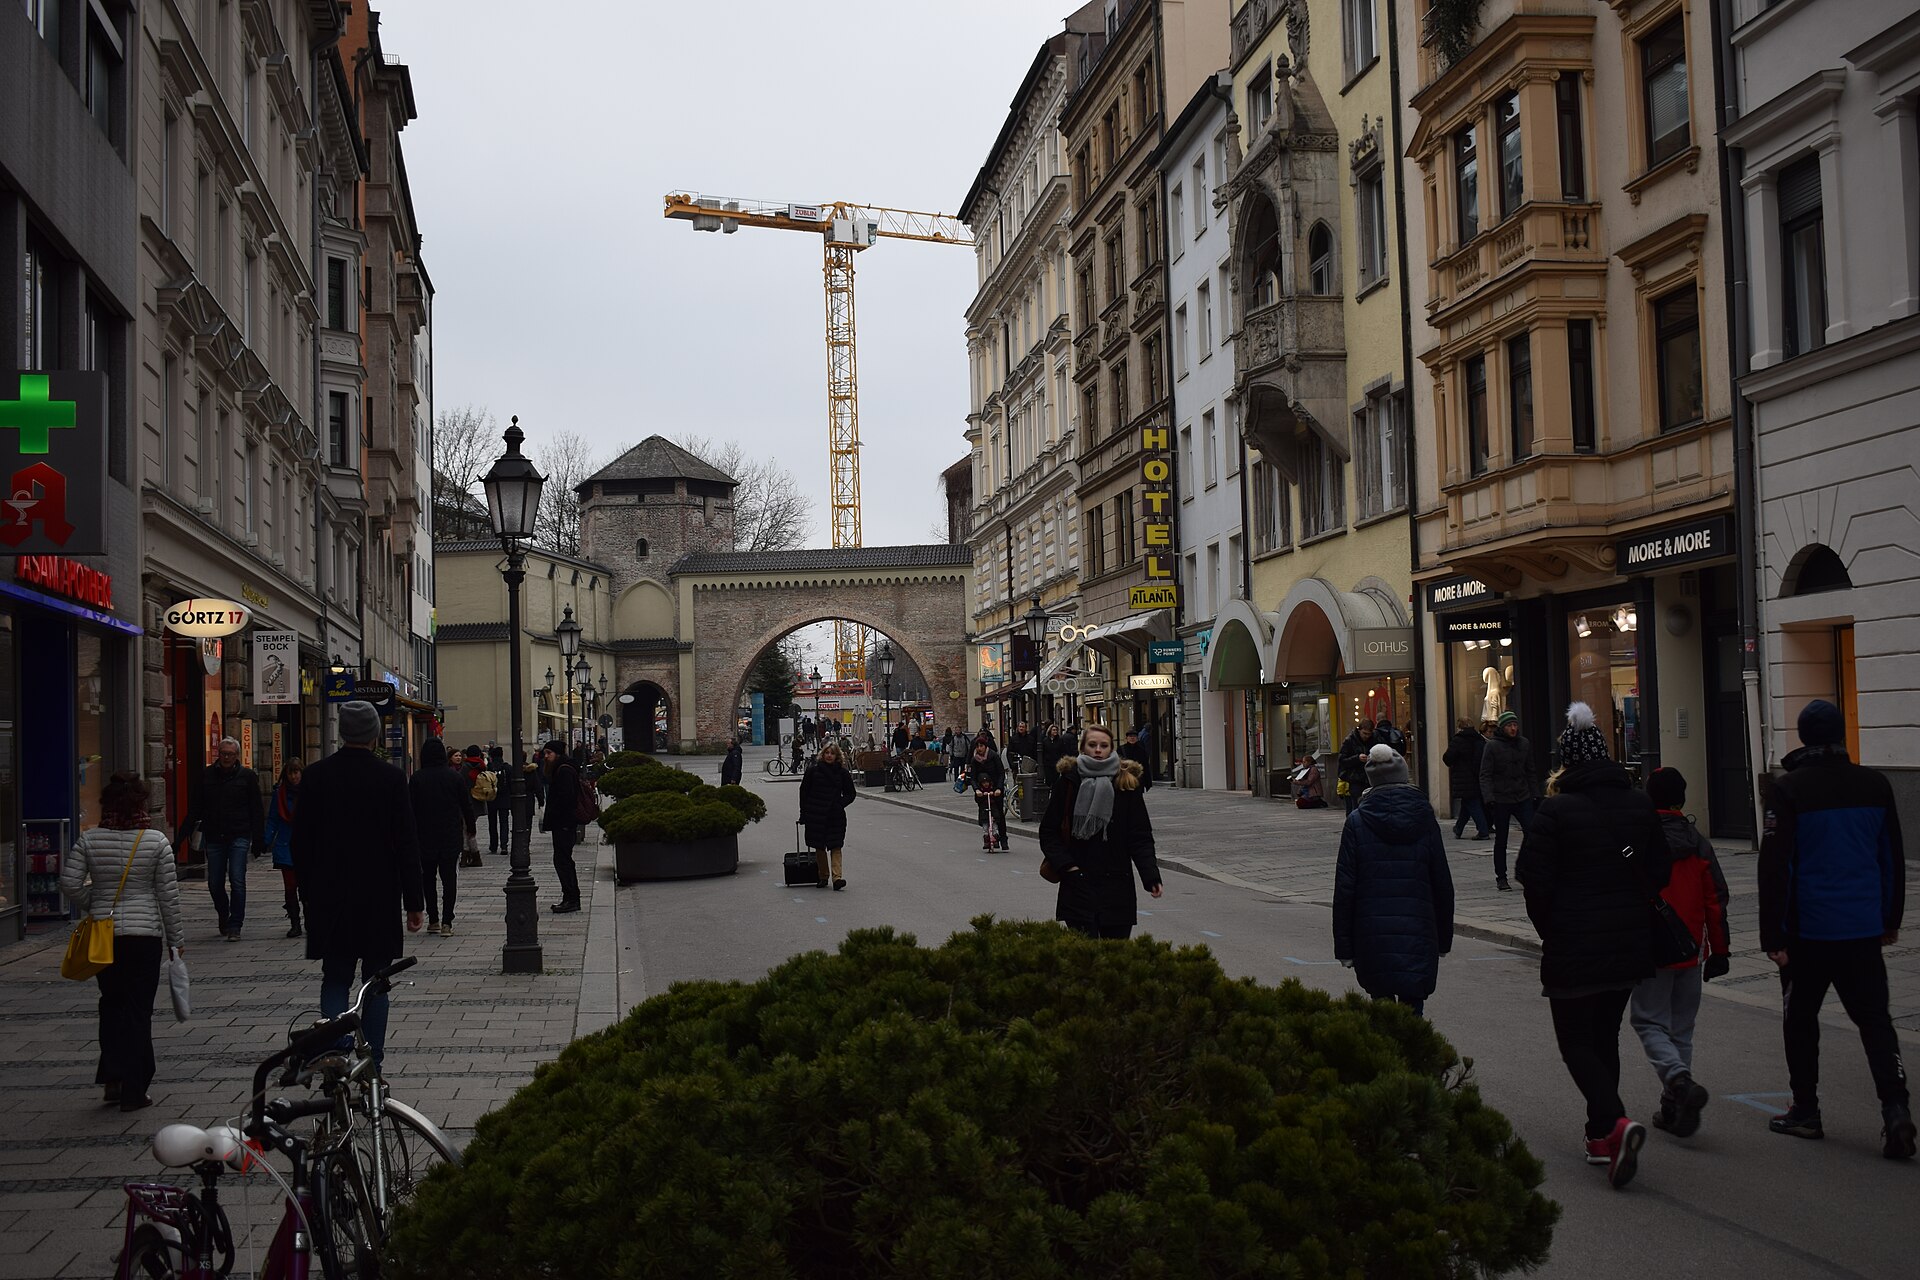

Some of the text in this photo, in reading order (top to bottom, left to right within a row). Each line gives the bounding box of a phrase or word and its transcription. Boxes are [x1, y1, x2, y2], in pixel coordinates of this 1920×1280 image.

[1143, 428, 1171, 577] HOTEL
[1628, 529, 1711, 564] MORE & MORE
[1131, 589, 1176, 605] ATLANTA
[1434, 580, 1487, 603] MORE & MORE
[229, 611, 244, 624] 17
[1449, 623, 1472, 631] MORE
[1479, 622, 1502, 630] MORE
[1363, 640, 1409, 653] LOTHUS
[1132, 678, 1171, 686] ARCADIA
